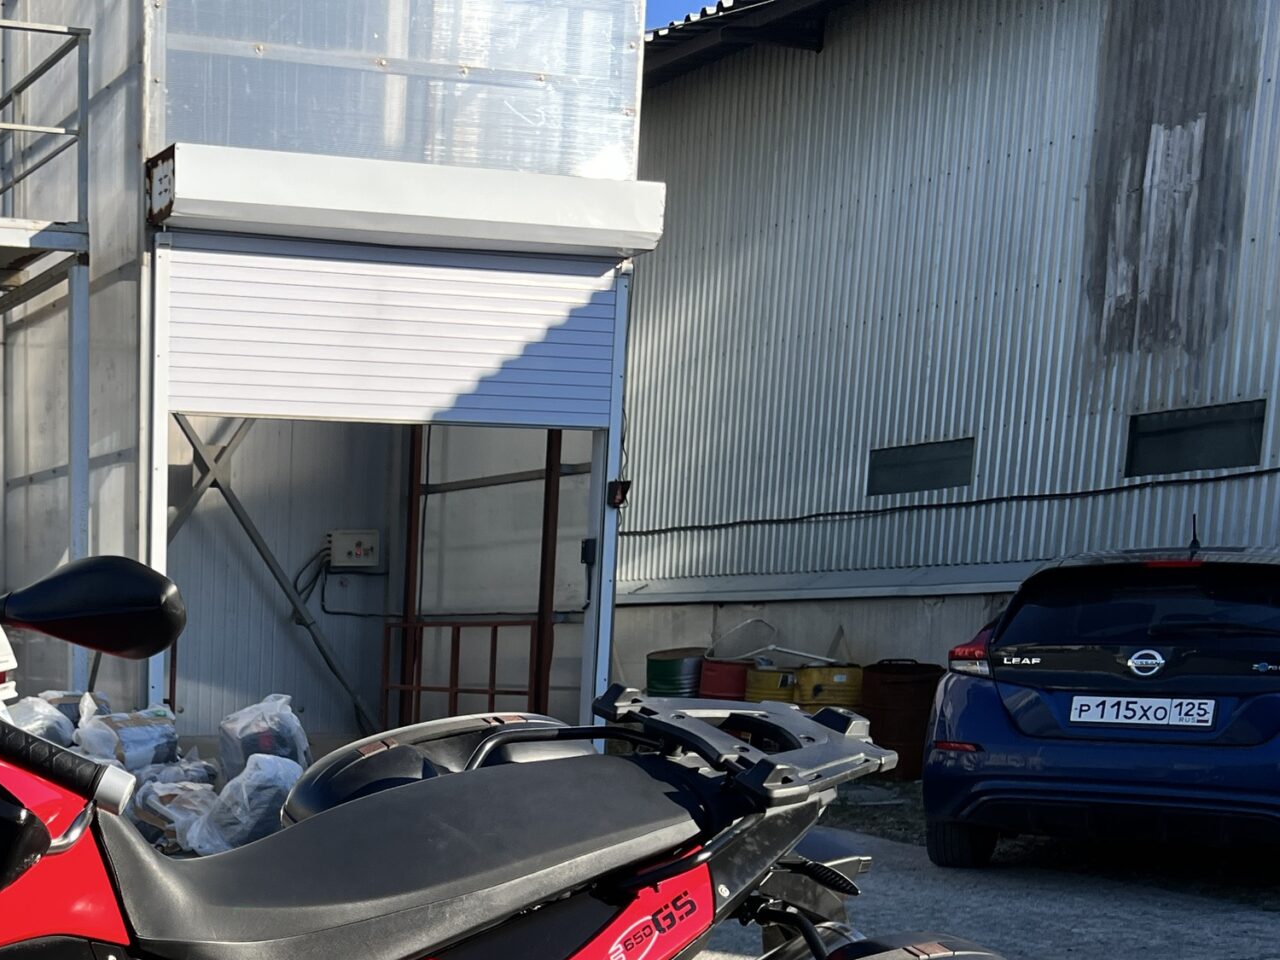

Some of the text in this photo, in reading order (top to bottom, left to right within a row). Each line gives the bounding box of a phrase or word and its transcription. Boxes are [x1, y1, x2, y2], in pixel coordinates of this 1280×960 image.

[1003, 656, 1041, 665] LEAF
[1174, 701, 1208, 717] 125
[651, 890, 697, 934] GS
